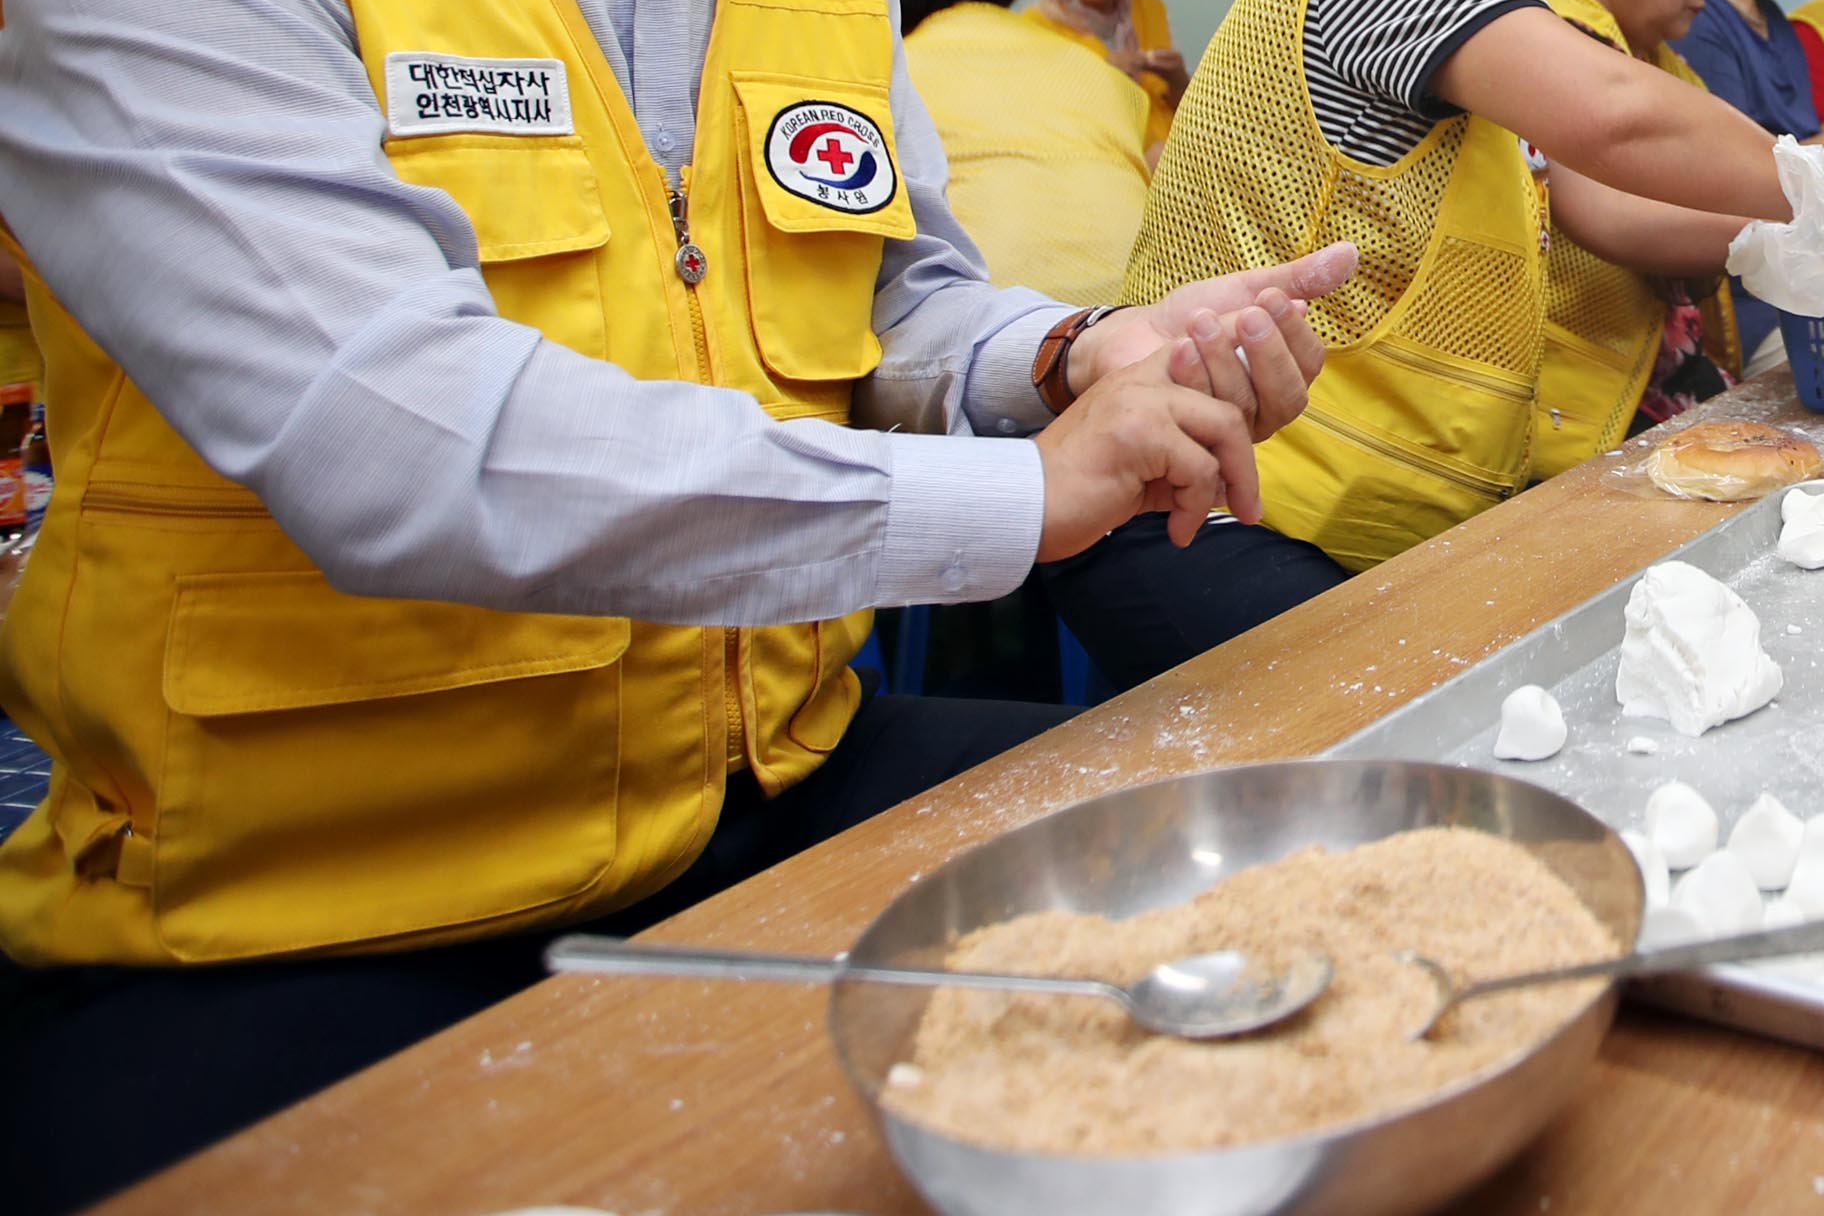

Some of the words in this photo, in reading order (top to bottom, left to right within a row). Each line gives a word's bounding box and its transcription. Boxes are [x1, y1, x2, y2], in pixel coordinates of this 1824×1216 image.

[408, 63, 550, 96] 대한적십자사
[415, 93, 552, 123] 인천광역시지사
[780, 110, 822, 140] KOREAN
[822, 109, 845, 123] RED
[848, 115, 880, 148] CROSS
